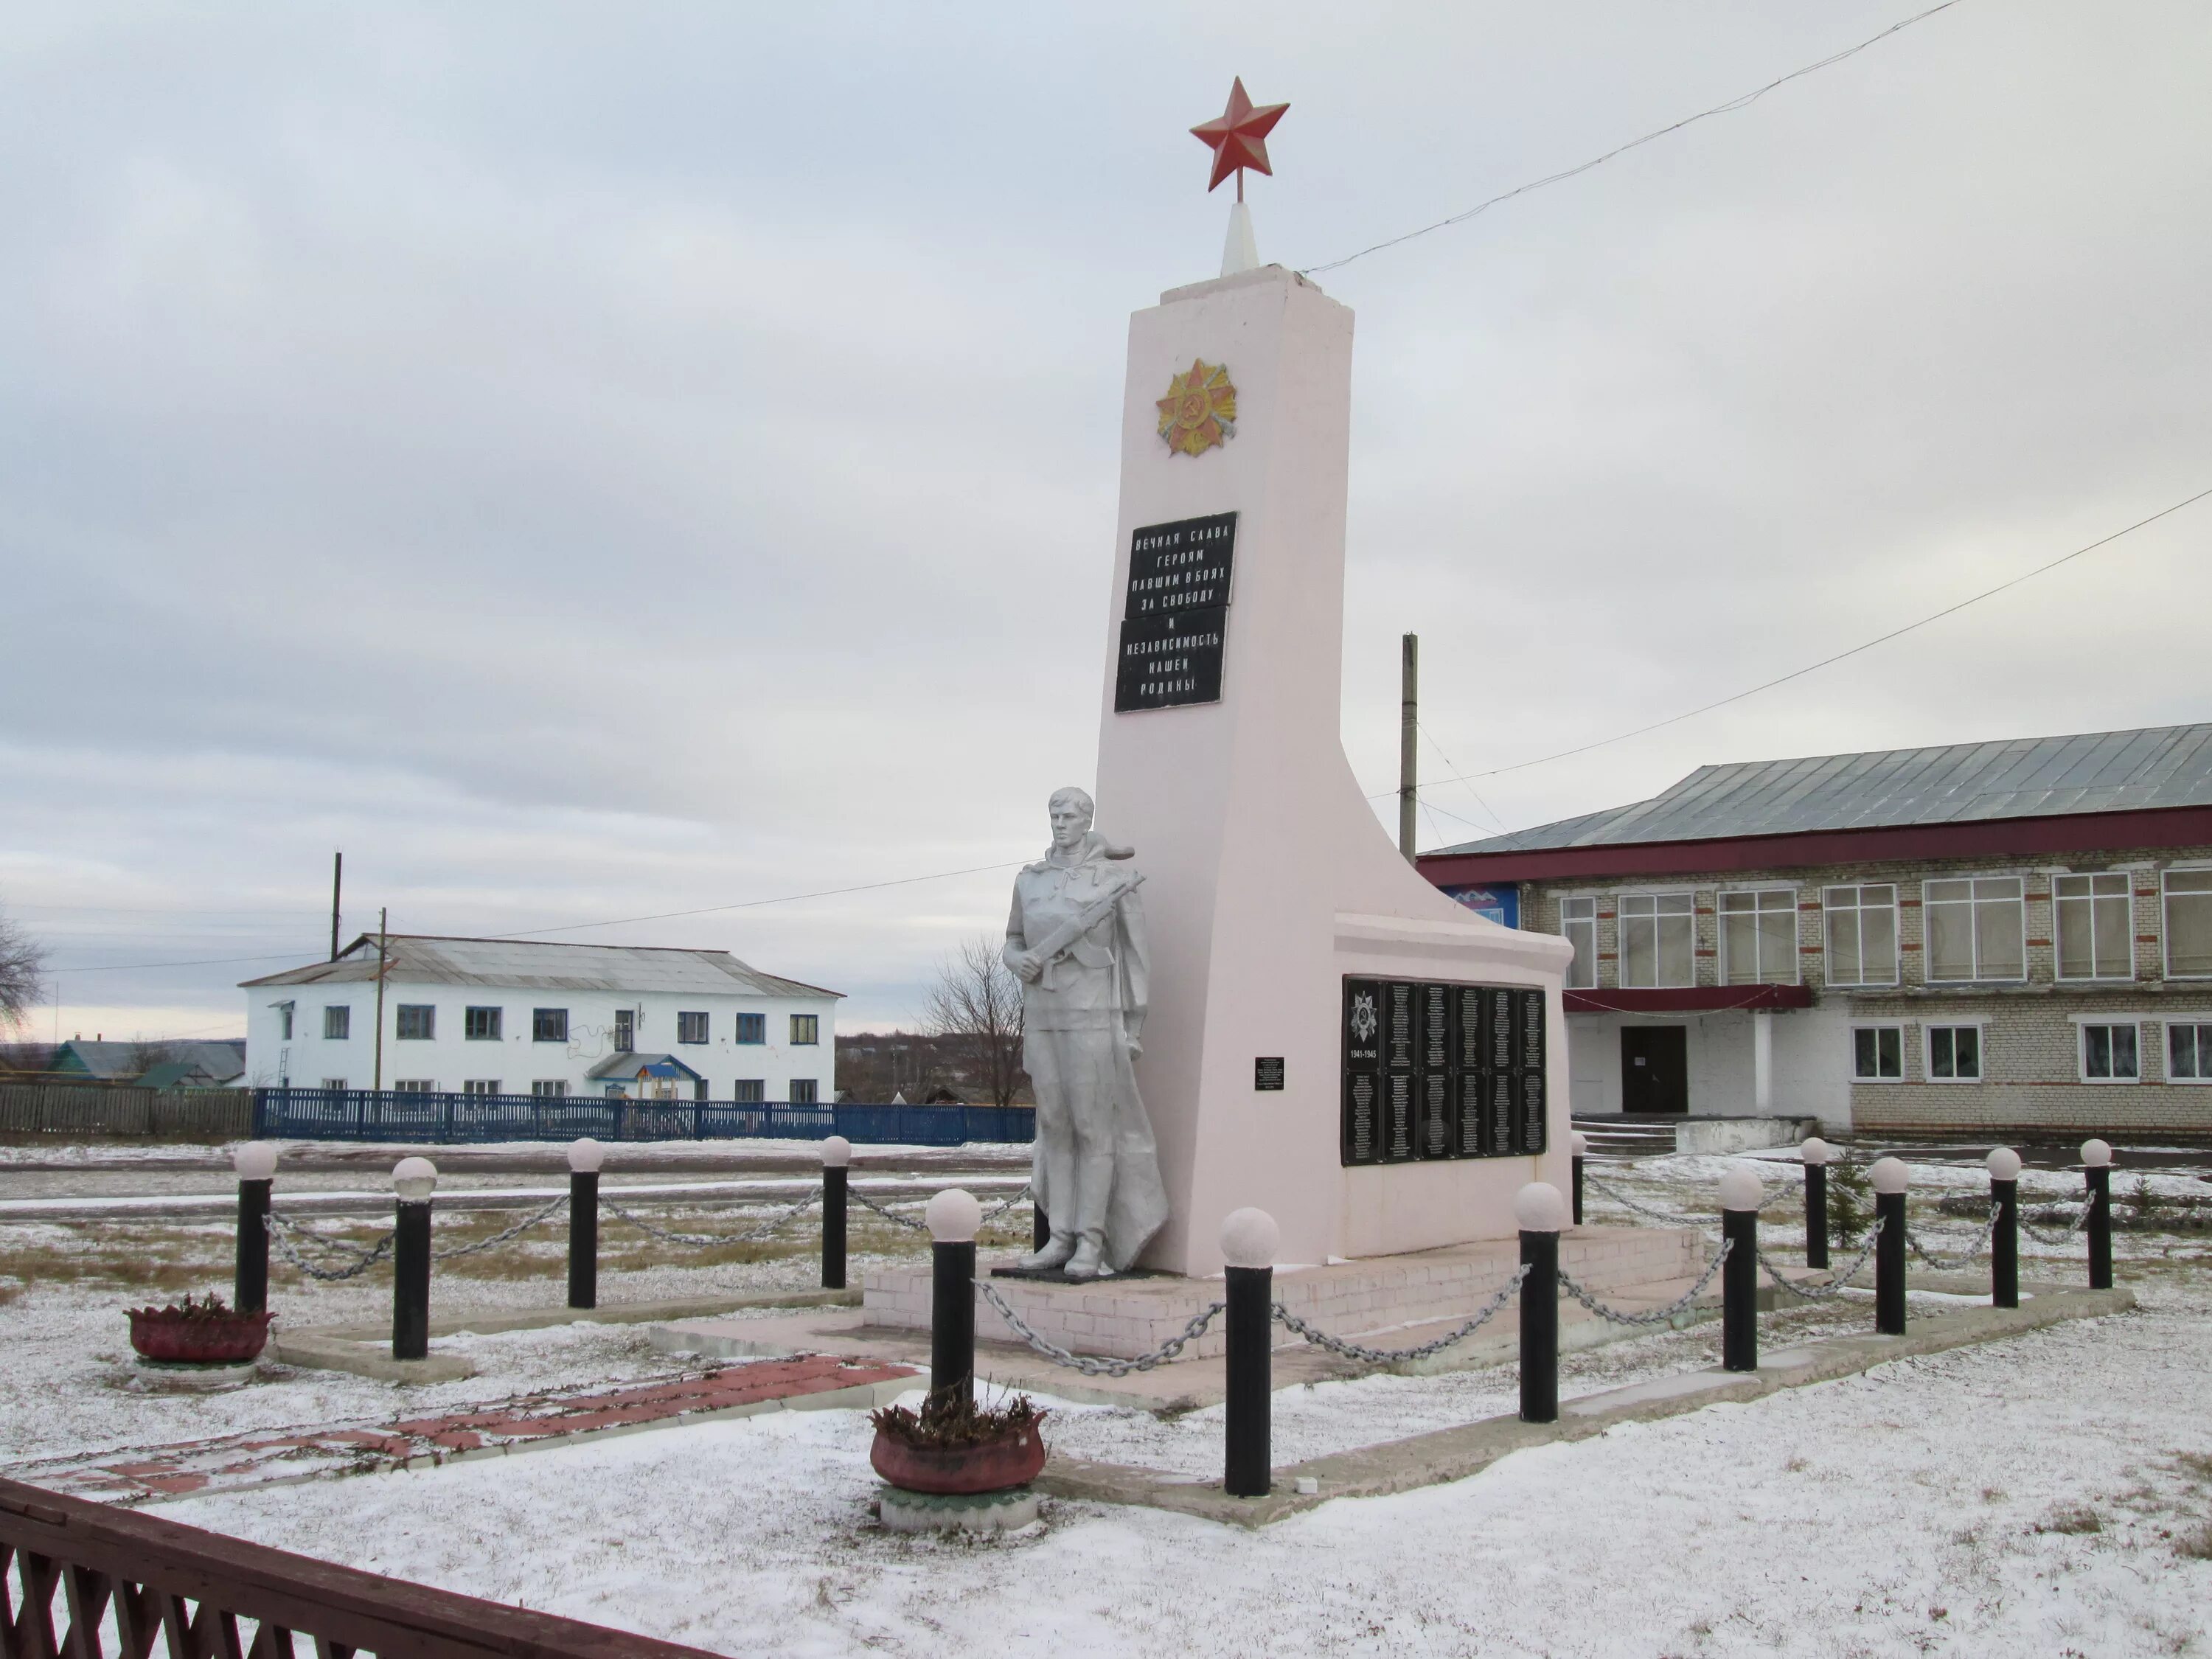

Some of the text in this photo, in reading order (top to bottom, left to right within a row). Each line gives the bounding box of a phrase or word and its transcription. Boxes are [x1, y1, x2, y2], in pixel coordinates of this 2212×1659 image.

[1136, 525, 1228, 550] ВЕЧНАЯ СЛАВА
[1157, 549, 1203, 568] ГЕРОЯМ
[1133, 567, 1224, 592] ПАВШИМ В БОЯХ
[1141, 589, 1214, 611] ЗА СВОБОДУ
[1169, 618, 1174, 629] И
[1127, 633, 1218, 655] НЕЗАВИСИМОСТЬ
[1141, 678, 1194, 695] РОДИНЫ
[1351, 1050, 1377, 1058] 1941-1945
